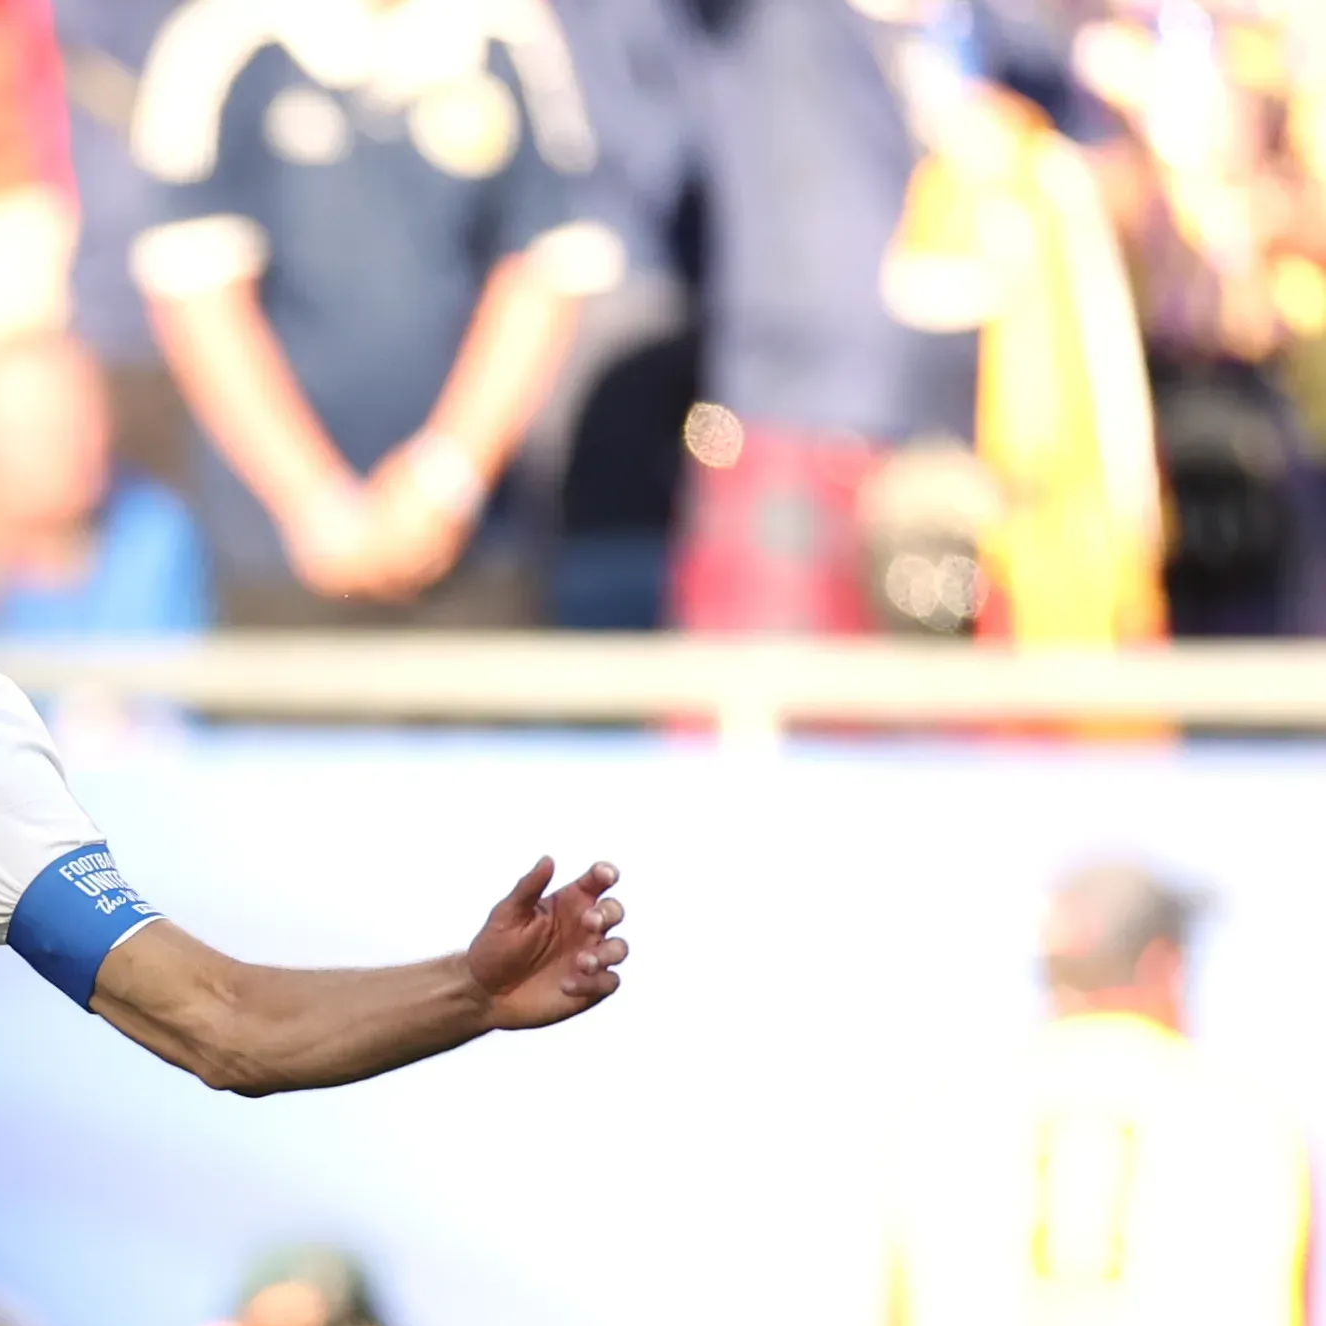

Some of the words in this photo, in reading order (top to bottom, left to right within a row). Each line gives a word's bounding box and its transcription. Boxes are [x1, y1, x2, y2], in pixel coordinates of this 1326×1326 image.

[58, 852, 116, 881] FOOTBA
[74, 870, 129, 897] UNITE
[95, 894, 126, 915] the
